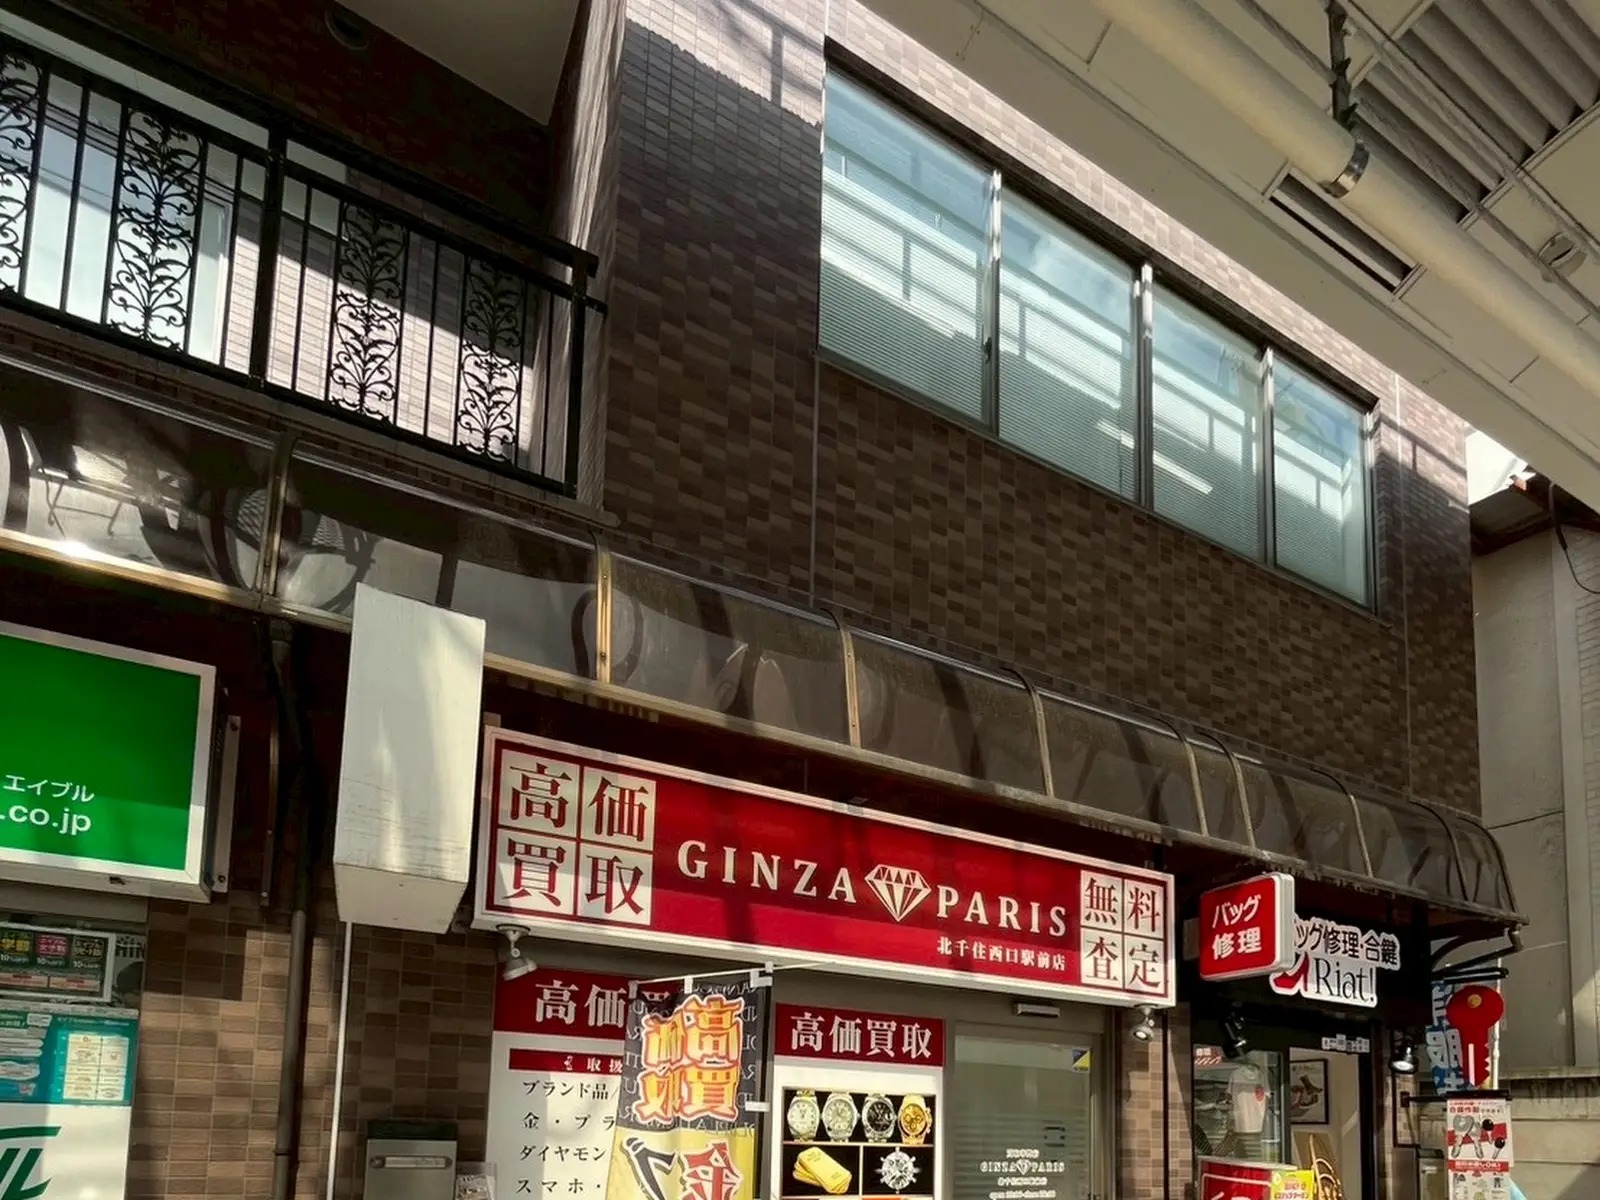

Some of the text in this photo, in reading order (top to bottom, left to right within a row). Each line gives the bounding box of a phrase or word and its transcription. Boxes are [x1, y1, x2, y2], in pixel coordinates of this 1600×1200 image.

[3, 774, 95, 802] エイブル
[508, 762, 650, 843] 高価
[501, 838, 645, 916] 買取
[677, 838, 1068, 938] GINZA PARIS
[1084, 877, 1161, 933] 無料
[1212, 892, 1263, 929] バッグ
[936, 935, 1067, 972] 北千住西口駅前店
[1084, 936, 1161, 989] 査定
[1212, 926, 1264, 961] 修理
[1293, 917, 1400, 967] ッグ修理・合鍵
[1314, 957, 1376, 1004] Riat!
[790, 1011, 933, 1060] 高価買取
[520, 1145, 606, 1162] ダイヤモン
